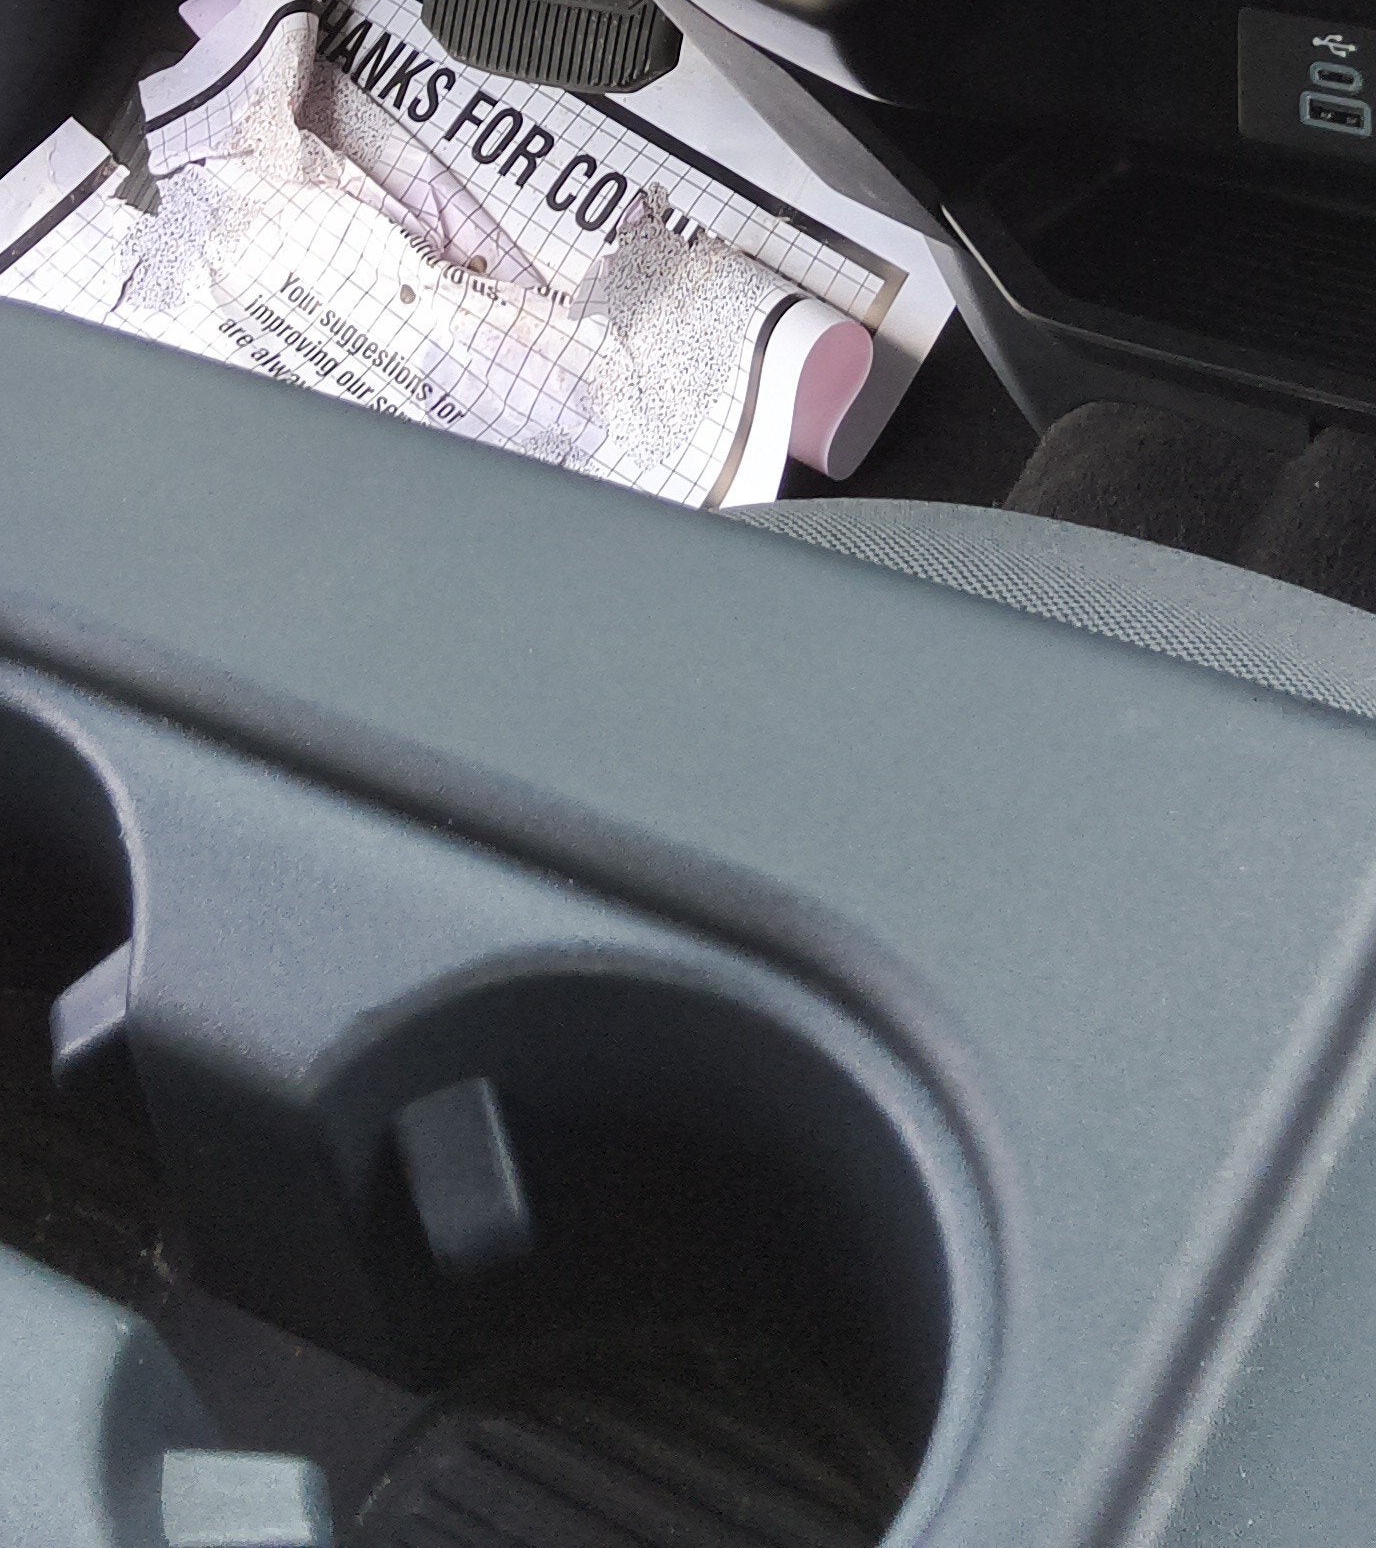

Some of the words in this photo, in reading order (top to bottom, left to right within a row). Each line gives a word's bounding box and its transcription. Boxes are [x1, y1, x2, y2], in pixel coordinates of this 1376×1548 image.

[443, 90, 555, 189] FOR
[218, 318, 254, 348] are
[244, 294, 340, 377] improving
[336, 370, 375, 400] our
[280, 271, 322, 316] Your
[319, 309, 433, 401] suggestions
[430, 392, 465, 424] for
